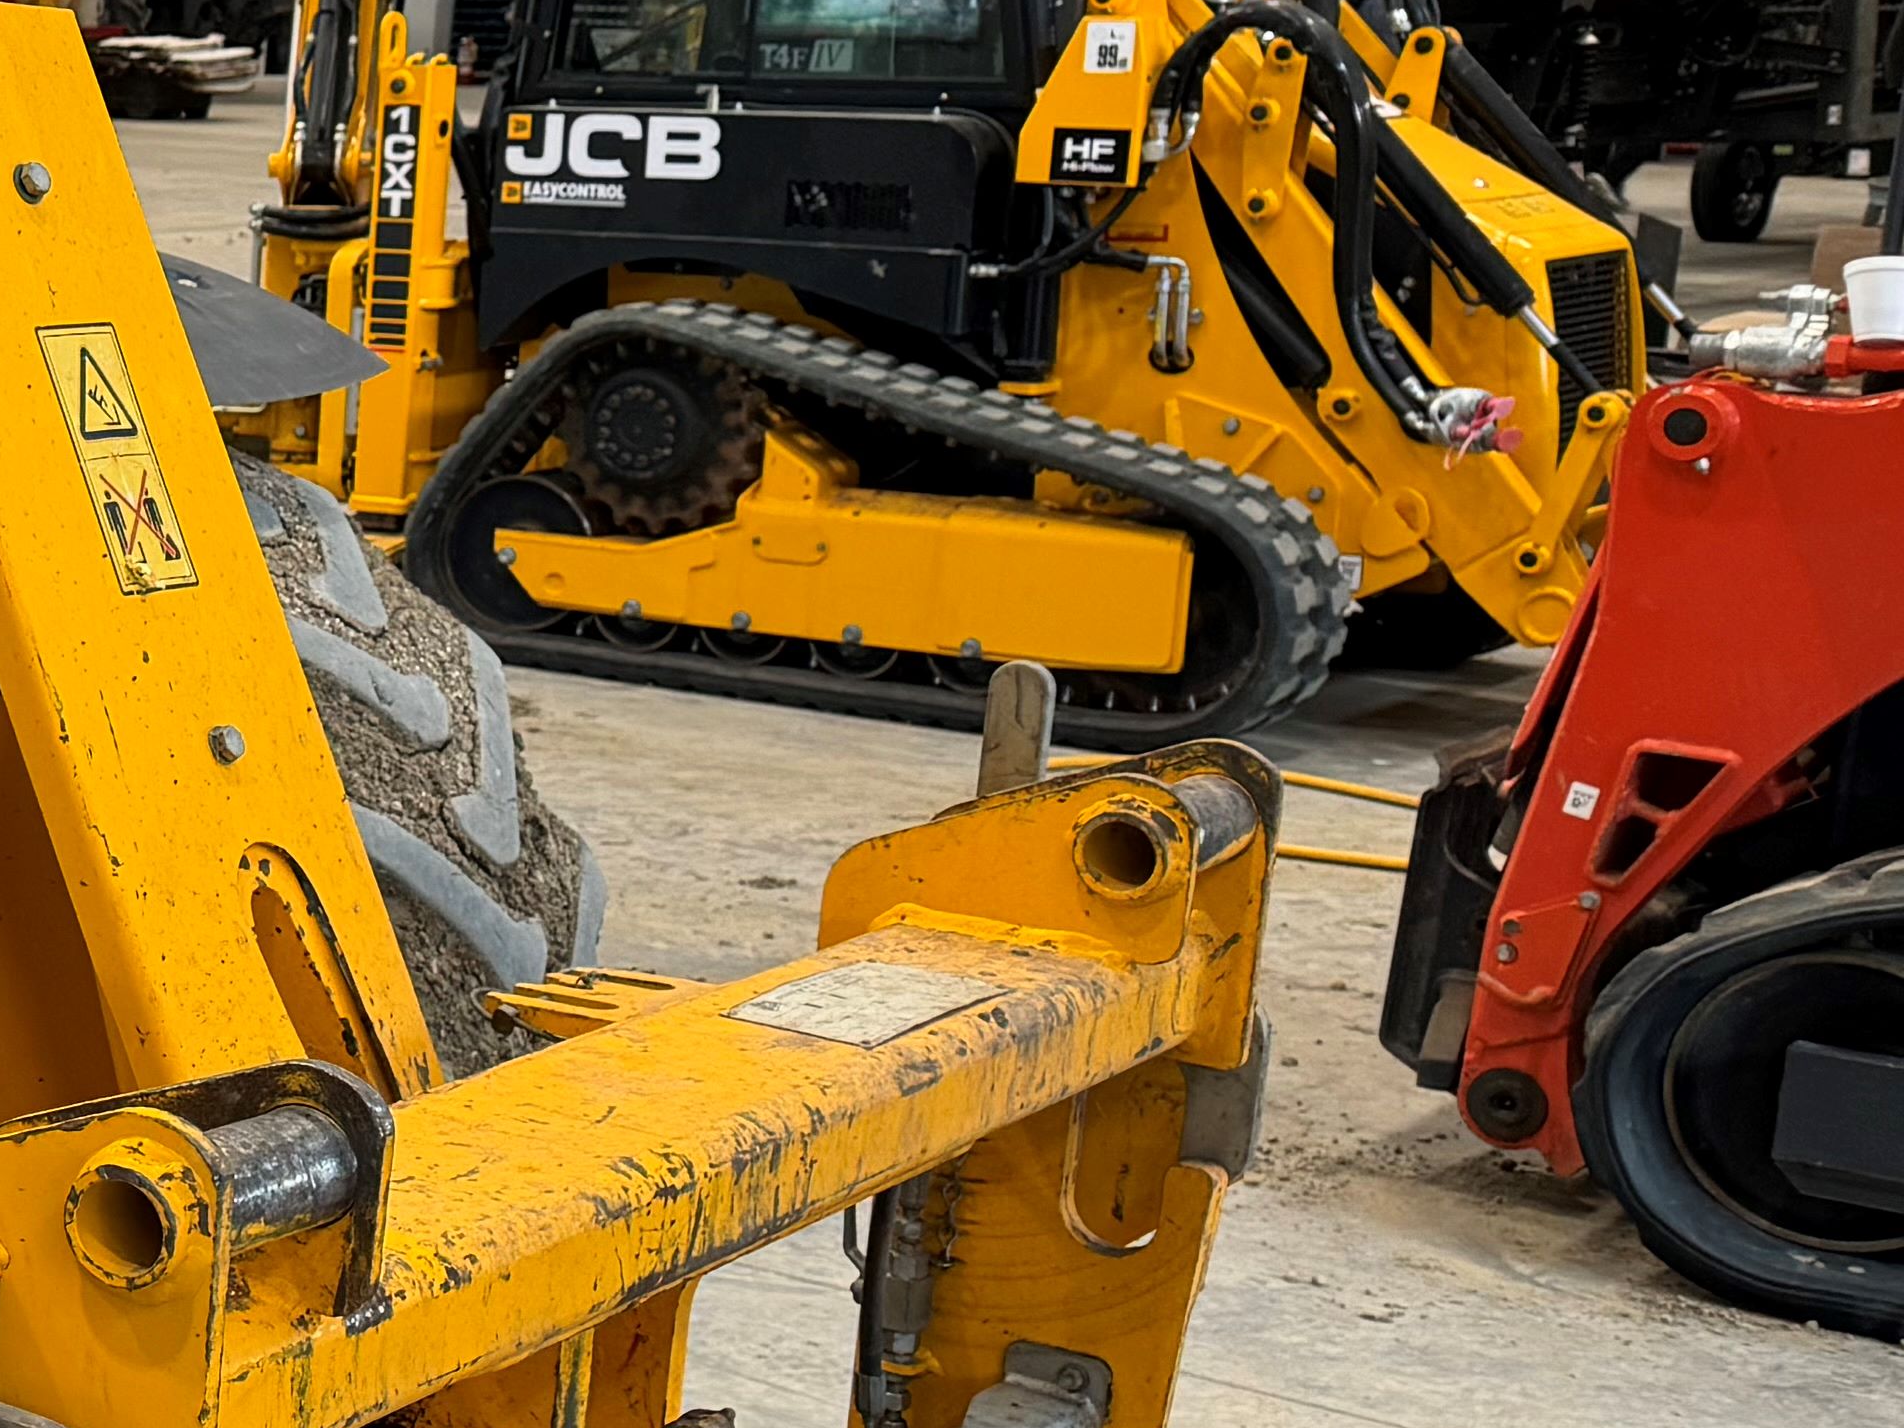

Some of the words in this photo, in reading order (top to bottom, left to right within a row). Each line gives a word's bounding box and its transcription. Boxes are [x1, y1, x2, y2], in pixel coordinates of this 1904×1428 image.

[1097, 44, 1119, 69] 99
[505, 113, 722, 180] JCB
[1063, 136, 1116, 161] HF
[380, 105, 416, 217] 1CXT
[523, 180, 626, 201] EASYCONTROL
